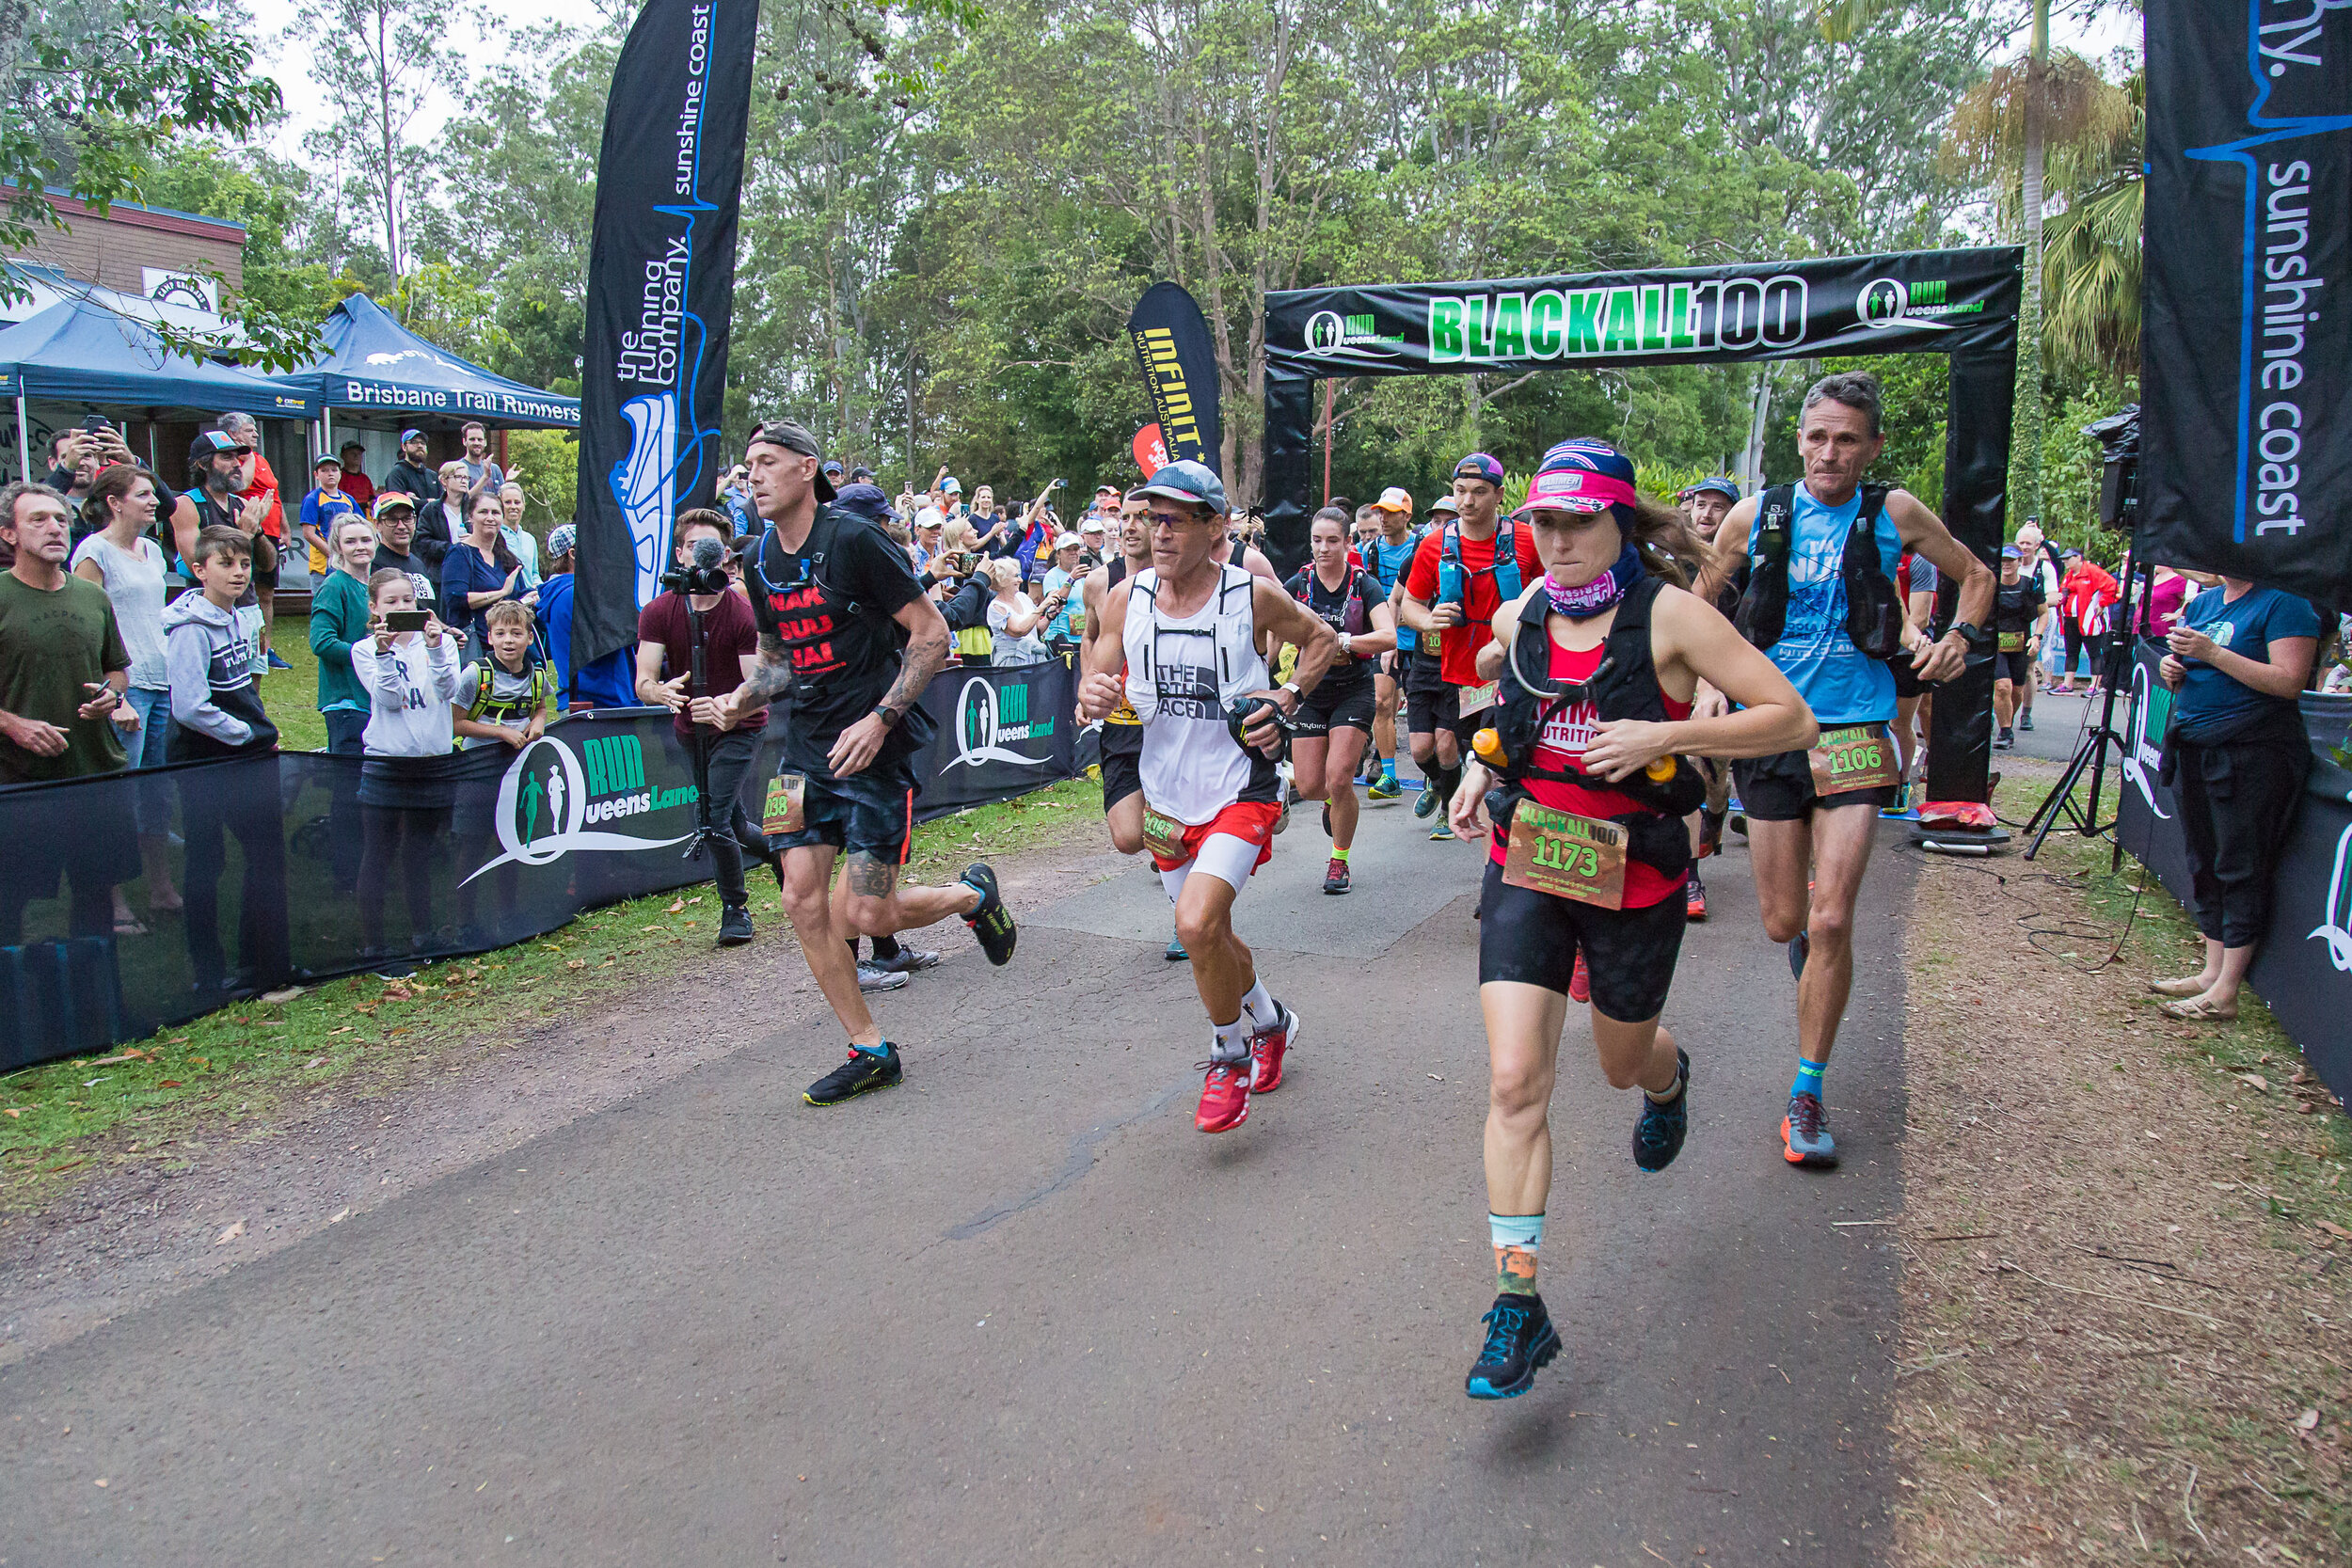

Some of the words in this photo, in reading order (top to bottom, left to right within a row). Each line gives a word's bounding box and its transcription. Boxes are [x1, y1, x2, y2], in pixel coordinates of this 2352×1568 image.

[675, 81, 702, 195] sunshine
[689, 5, 709, 75] coast
[157, 281, 176, 298] CAMP
[1910, 280, 1947, 305] RUN
[2262, 160, 2324, 389] sunshine
[639, 261, 668, 383] running
[658, 236, 690, 385] company.
[1345, 314, 1375, 335] RUN
[617, 331, 639, 381] the
[347, 382, 447, 406] Brisbane
[451, 388, 497, 411] Trail
[502, 395, 581, 421] Runners
[1135, 331, 1161, 395] NUTRITION
[1155, 397, 1181, 461] AUSTRALIA
[2255, 402, 2306, 536] coast
[768, 586, 827, 611] NAK
[1157, 664, 1195, 682] THE
[1157, 682, 1196, 694] RTH
[1000, 684, 1028, 724] RUN
[1158, 699, 1196, 719] ACE
[1469, 685, 1493, 705] 1119
[1543, 726, 1598, 744] UTRITI
[583, 735, 645, 797] RUN
[1827, 745, 1882, 774] 1106
[1532, 835, 1598, 878] 1173
